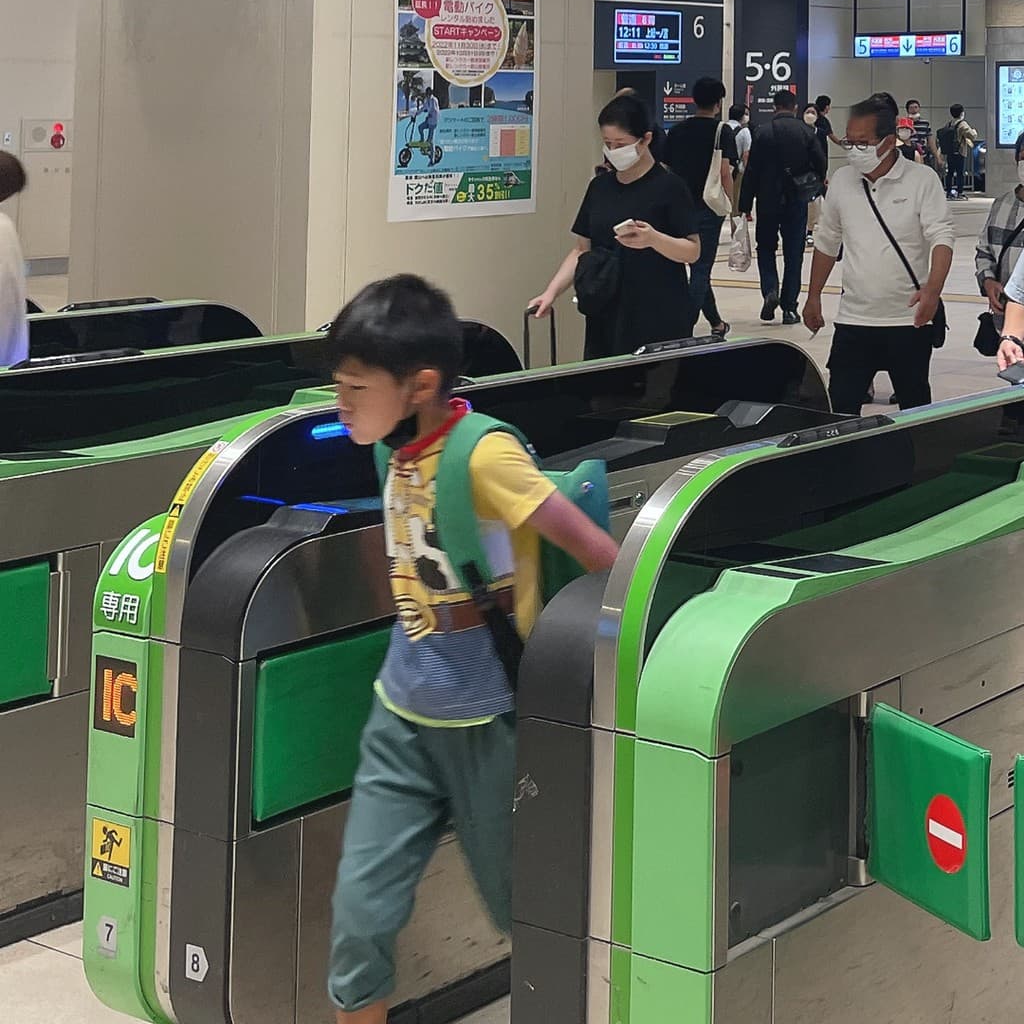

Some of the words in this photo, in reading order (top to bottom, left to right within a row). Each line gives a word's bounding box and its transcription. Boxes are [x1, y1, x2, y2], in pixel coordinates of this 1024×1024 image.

[443, 0, 494, 15] 電動バイク
[693, 15, 705, 38] 6
[859, 39, 867, 54] 5
[950, 37, 958, 52] 6
[109, 528, 160, 580] IC
[100, 591, 139, 624] 専用
[103, 669, 137, 726] IC
[105, 923, 114, 942] 7
[191, 953, 200, 973] 8
